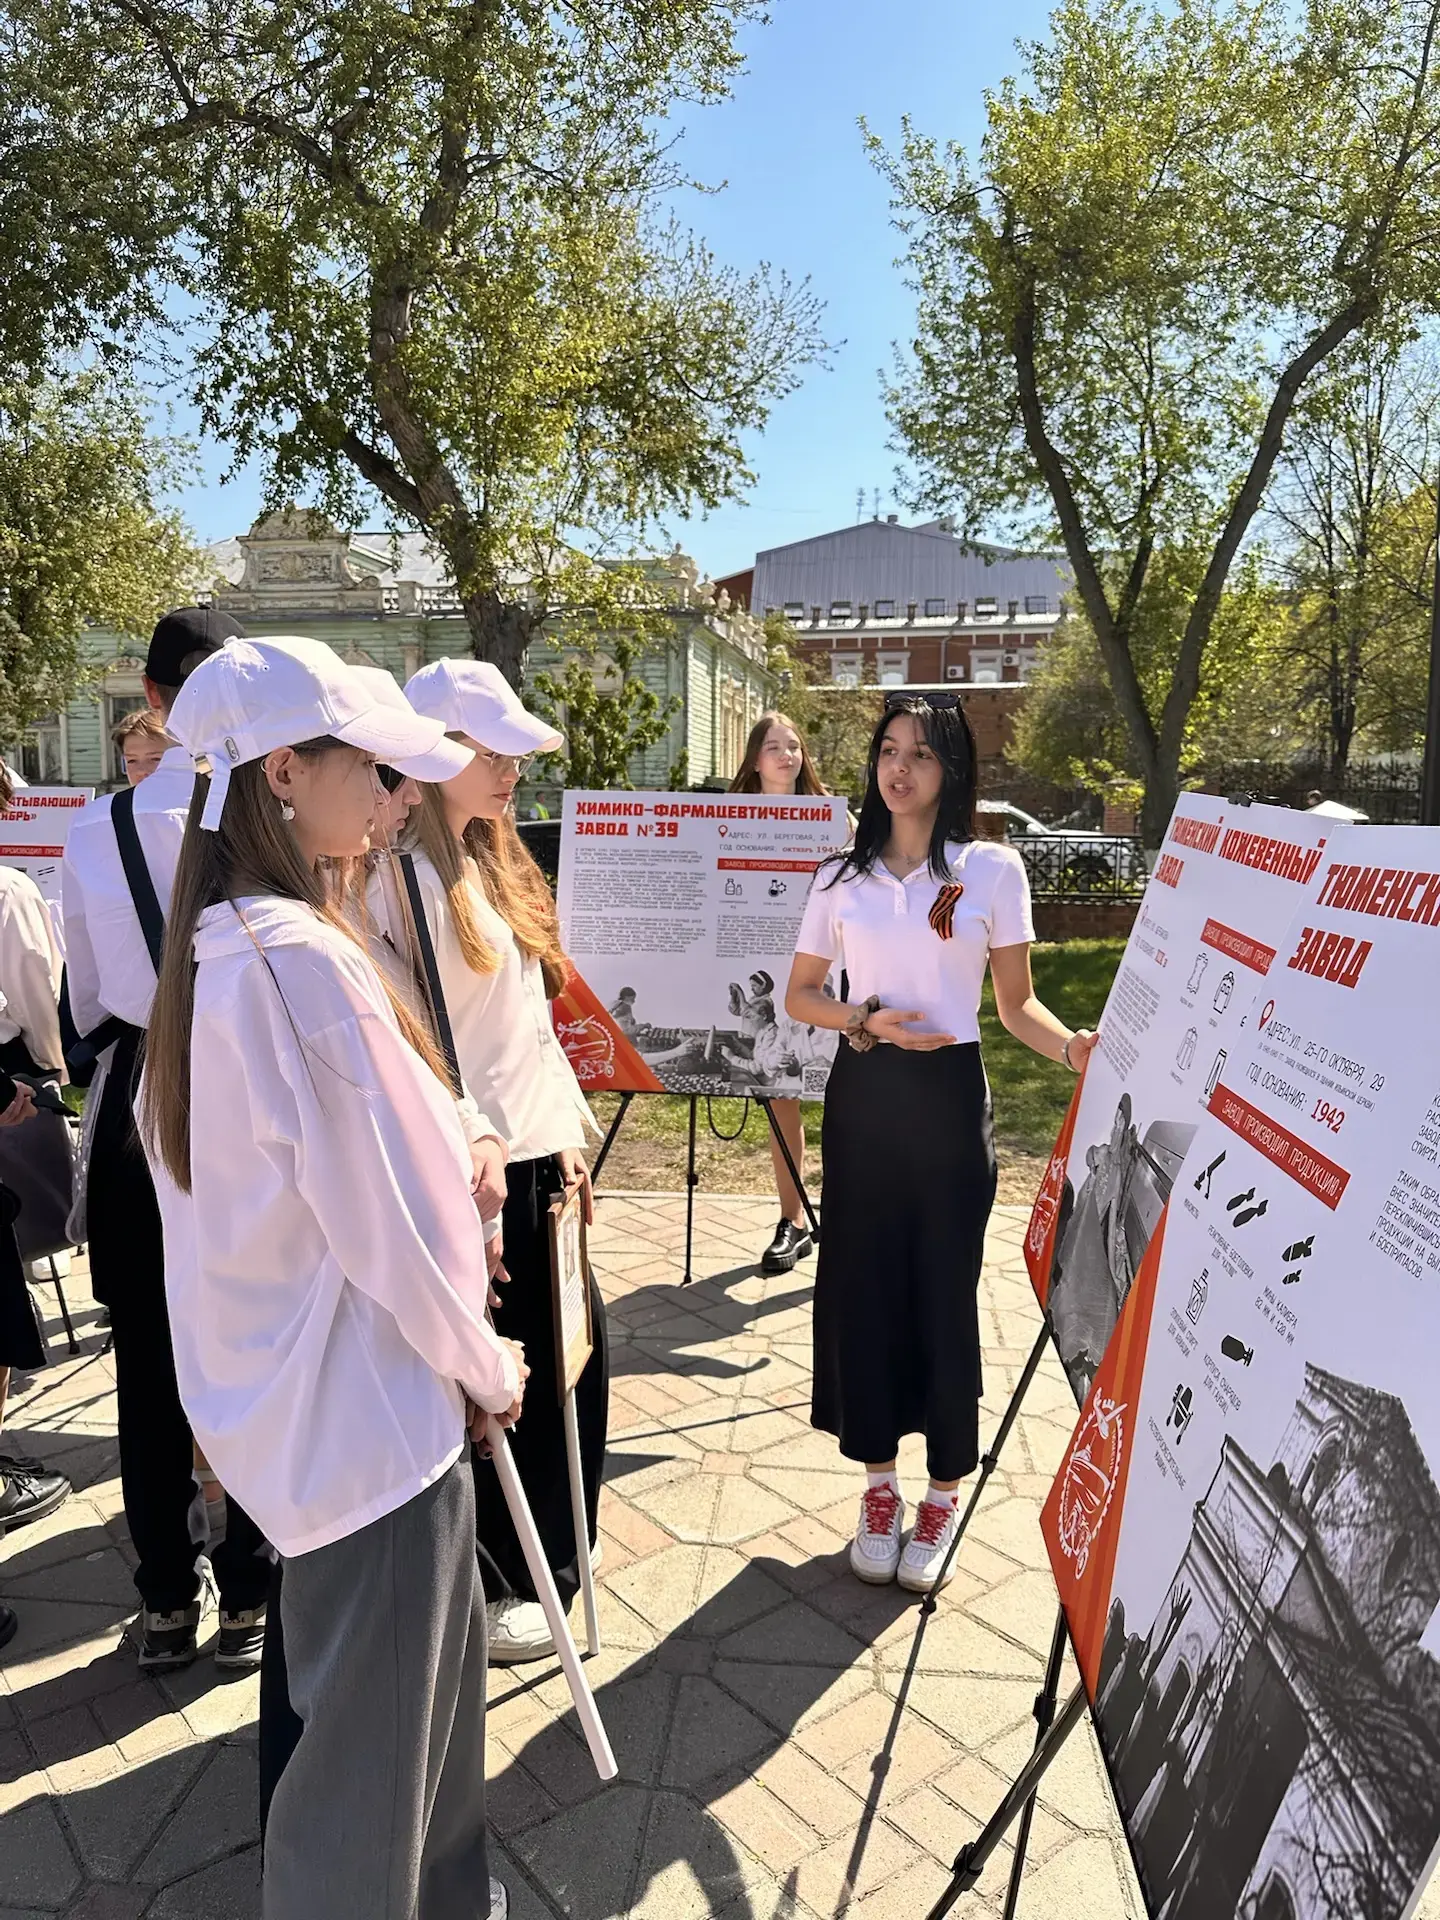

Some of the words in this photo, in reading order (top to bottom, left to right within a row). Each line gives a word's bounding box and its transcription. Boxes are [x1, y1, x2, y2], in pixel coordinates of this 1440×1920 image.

[575, 821, 629, 836] ЗАВОД
[576, 801, 833, 822] ХИМИКО-ФАРМАЦЕВТИЧЕСКИЙ
[719, 843, 733, 852] ГОД
[728, 831, 753, 840] АДРЕС:
[820, 834, 830, 842] 24
[1169, 816, 1224, 854] ТЮМЕНСКИЙ
[1218, 828, 1327, 885] КОЖЕВЕННЫЙ
[724, 860, 746, 870] ЗАВОД
[1154, 853, 1185, 889] ЗАВОД
[1287, 927, 1374, 989] ЗАВОД
[1303, 1040, 1329, 1064] 25-ГО
[1328, 1052, 1366, 1088] ОКТЯБРЯ,
[1369, 1072, 1386, 1092] 29
[1246, 1062, 1263, 1086] ГОД
[1261, 1071, 1308, 1112] ОСНОВАНИЯ:
[1310, 1098, 1346, 1135] 1942
[1221, 1098, 1245, 1129] ЗАВОД
[1243, 1114, 1291, 1159] ПРОИЗВОДИЛ
[1287, 1147, 1343, 1201] ПРОДУКЦИЮ:
[1411, 1140, 1438, 1165] СПИРТА
[1397, 1169, 1421, 1193] ТАКИМ
[1389, 1185, 1409, 1205] ВНЕС
[1408, 1197, 1440, 1229] ЗНАЧИТЕ
[1369, 1230, 1377, 1243] И
[1376, 1235, 1423, 1281] БОЕПРИПАСОВ.
[1376, 1215, 1415, 1251] ПРОДУКЦИИ
[1414, 1243, 1426, 1261] НА
[156, 1617, 179, 1626] PULSE
